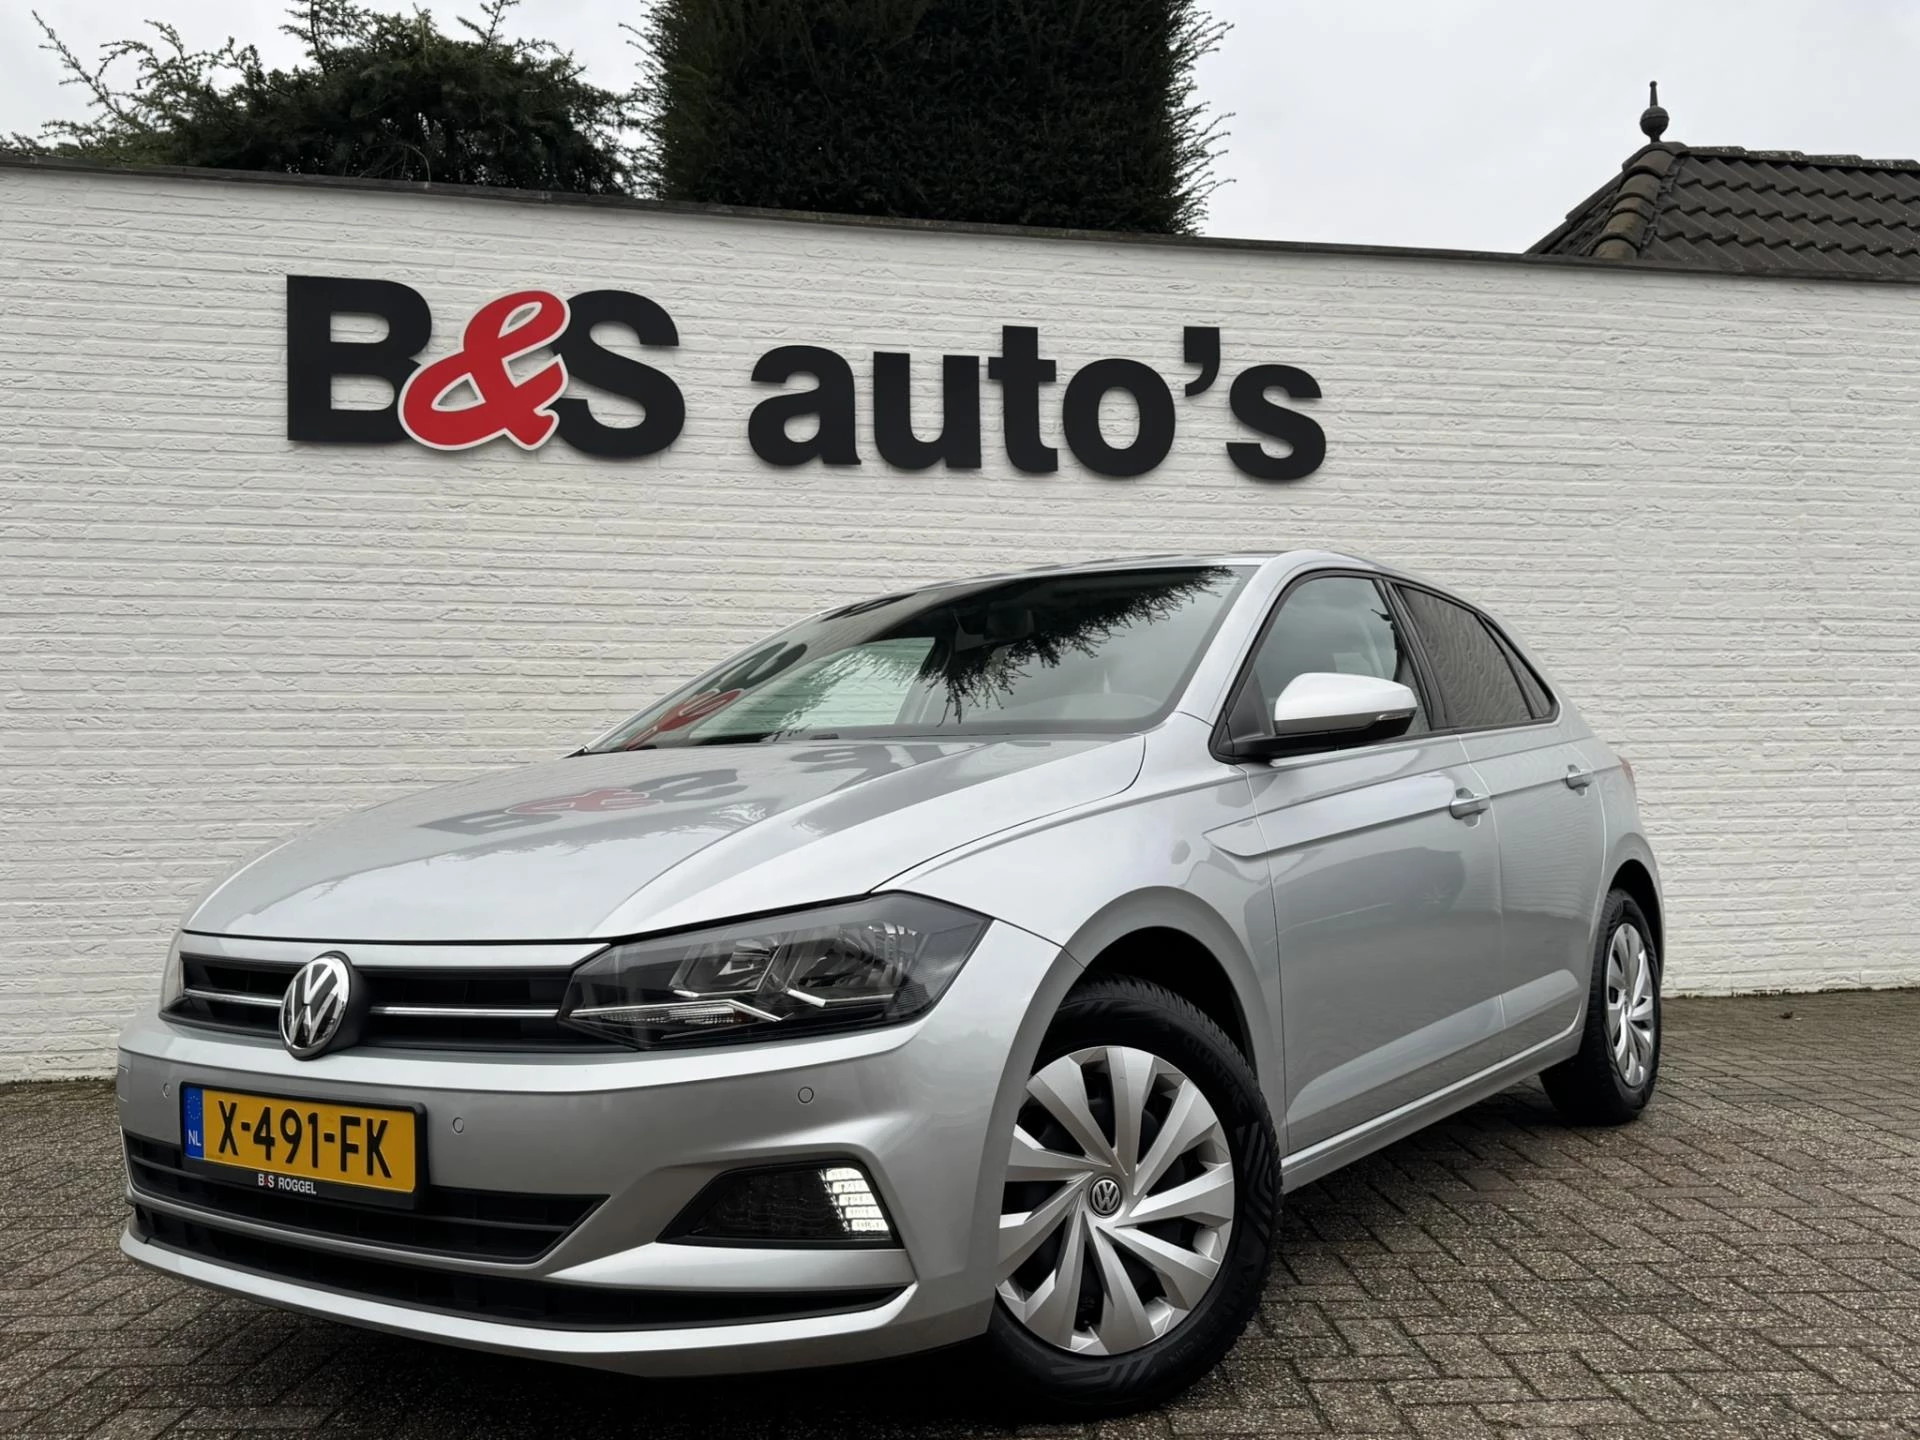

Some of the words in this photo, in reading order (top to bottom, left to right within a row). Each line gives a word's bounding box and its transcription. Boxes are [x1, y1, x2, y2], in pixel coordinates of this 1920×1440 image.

[287, 275, 685, 460] B&S
[748, 325, 1328, 482] auto's
[188, 1129, 202, 1147] NL
[218, 1100, 392, 1178] X-491-FK
[278, 1176, 317, 1195] ROGGEL
